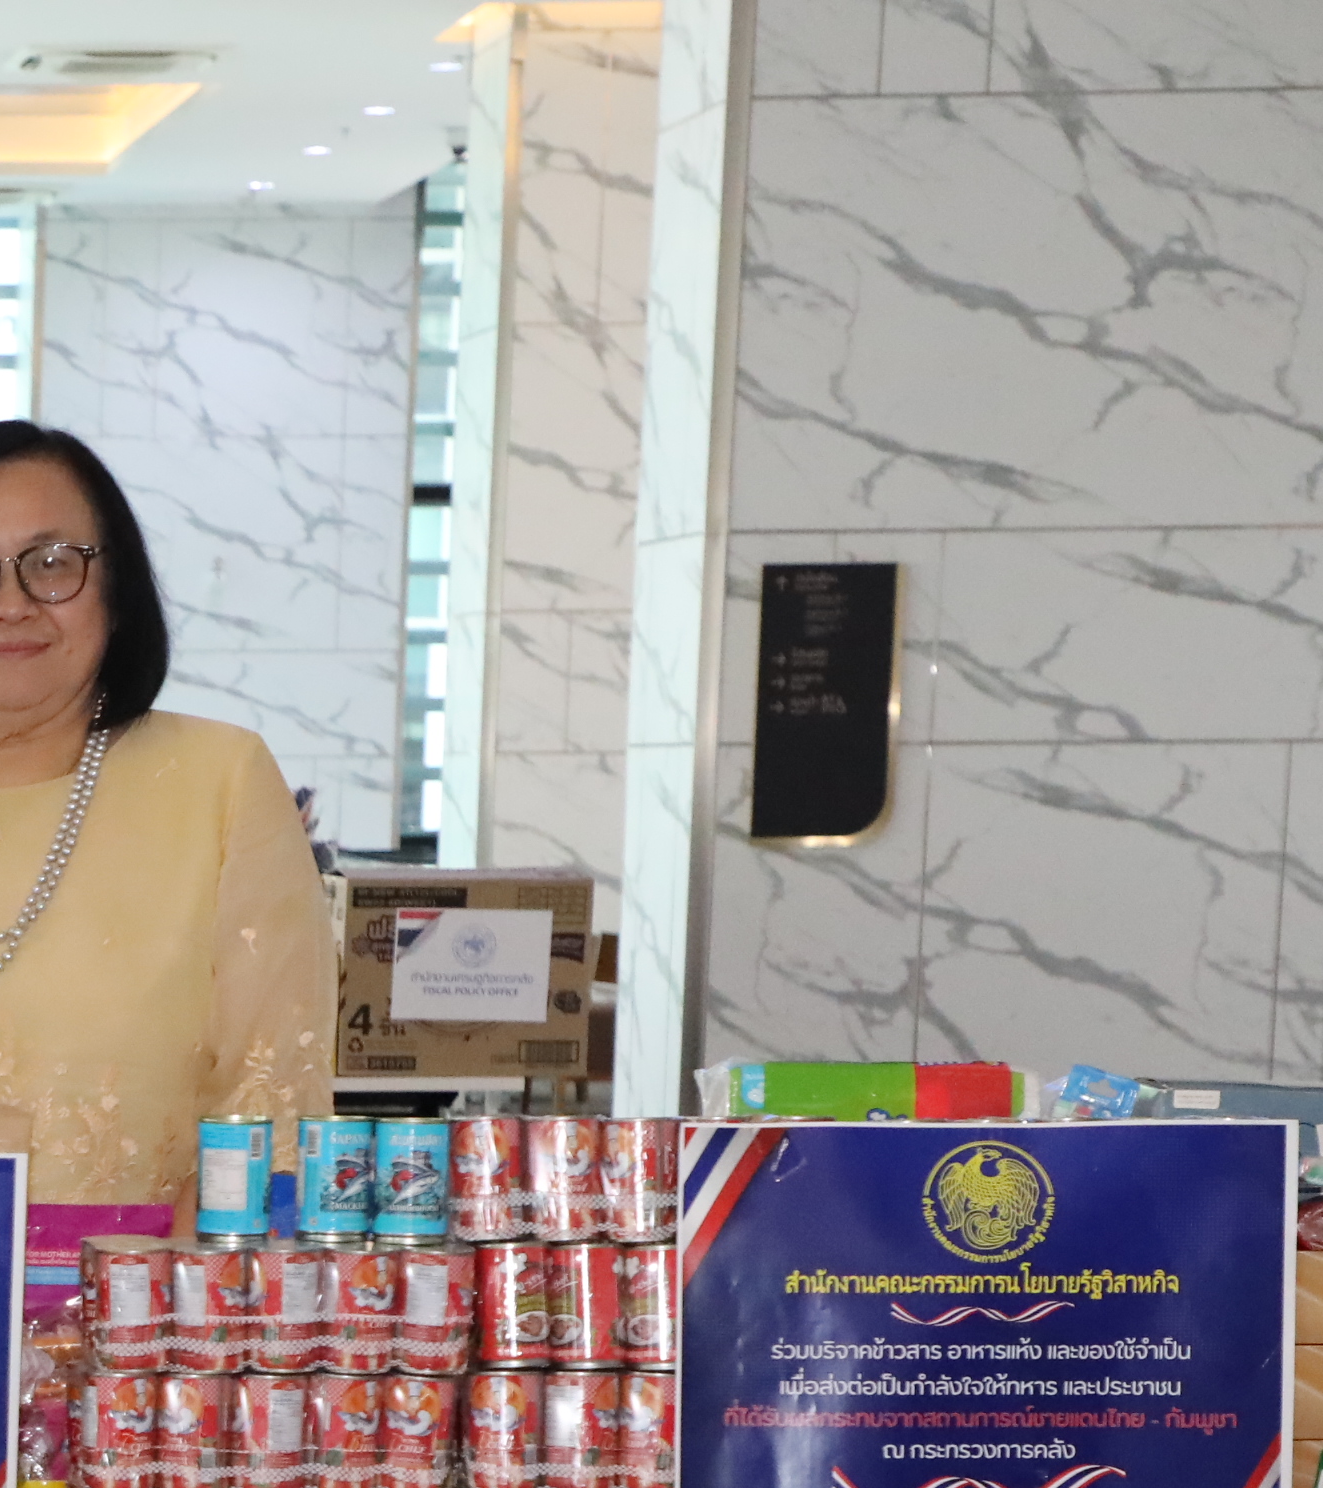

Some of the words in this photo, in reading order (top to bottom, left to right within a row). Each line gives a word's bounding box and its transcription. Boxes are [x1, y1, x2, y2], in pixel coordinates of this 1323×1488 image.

[349, 1004, 372, 1036] 4
[785, 1263, 1179, 1300] สำนักงานคณะกรรมการนโยบายรัฐวิสาหกิจ
[770, 1337, 942, 1362] ร่วมบริจาคข้าวสาร
[947, 1339, 1042, 1362] อาหารแห้ง
[1047, 1338, 1192, 1364] และของใช้จำเป็น
[779, 1367, 1057, 1398] เพื่อส่งต่อเป็นกำลังใจให้ทหาร
[1063, 1377, 1182, 1398] และประชาชน
[1164, 1408, 1237, 1436] กัมพูชา
[882, 1442, 904, 1460] ณ
[909, 1438, 1076, 1462] กระทรวงการคลัง
